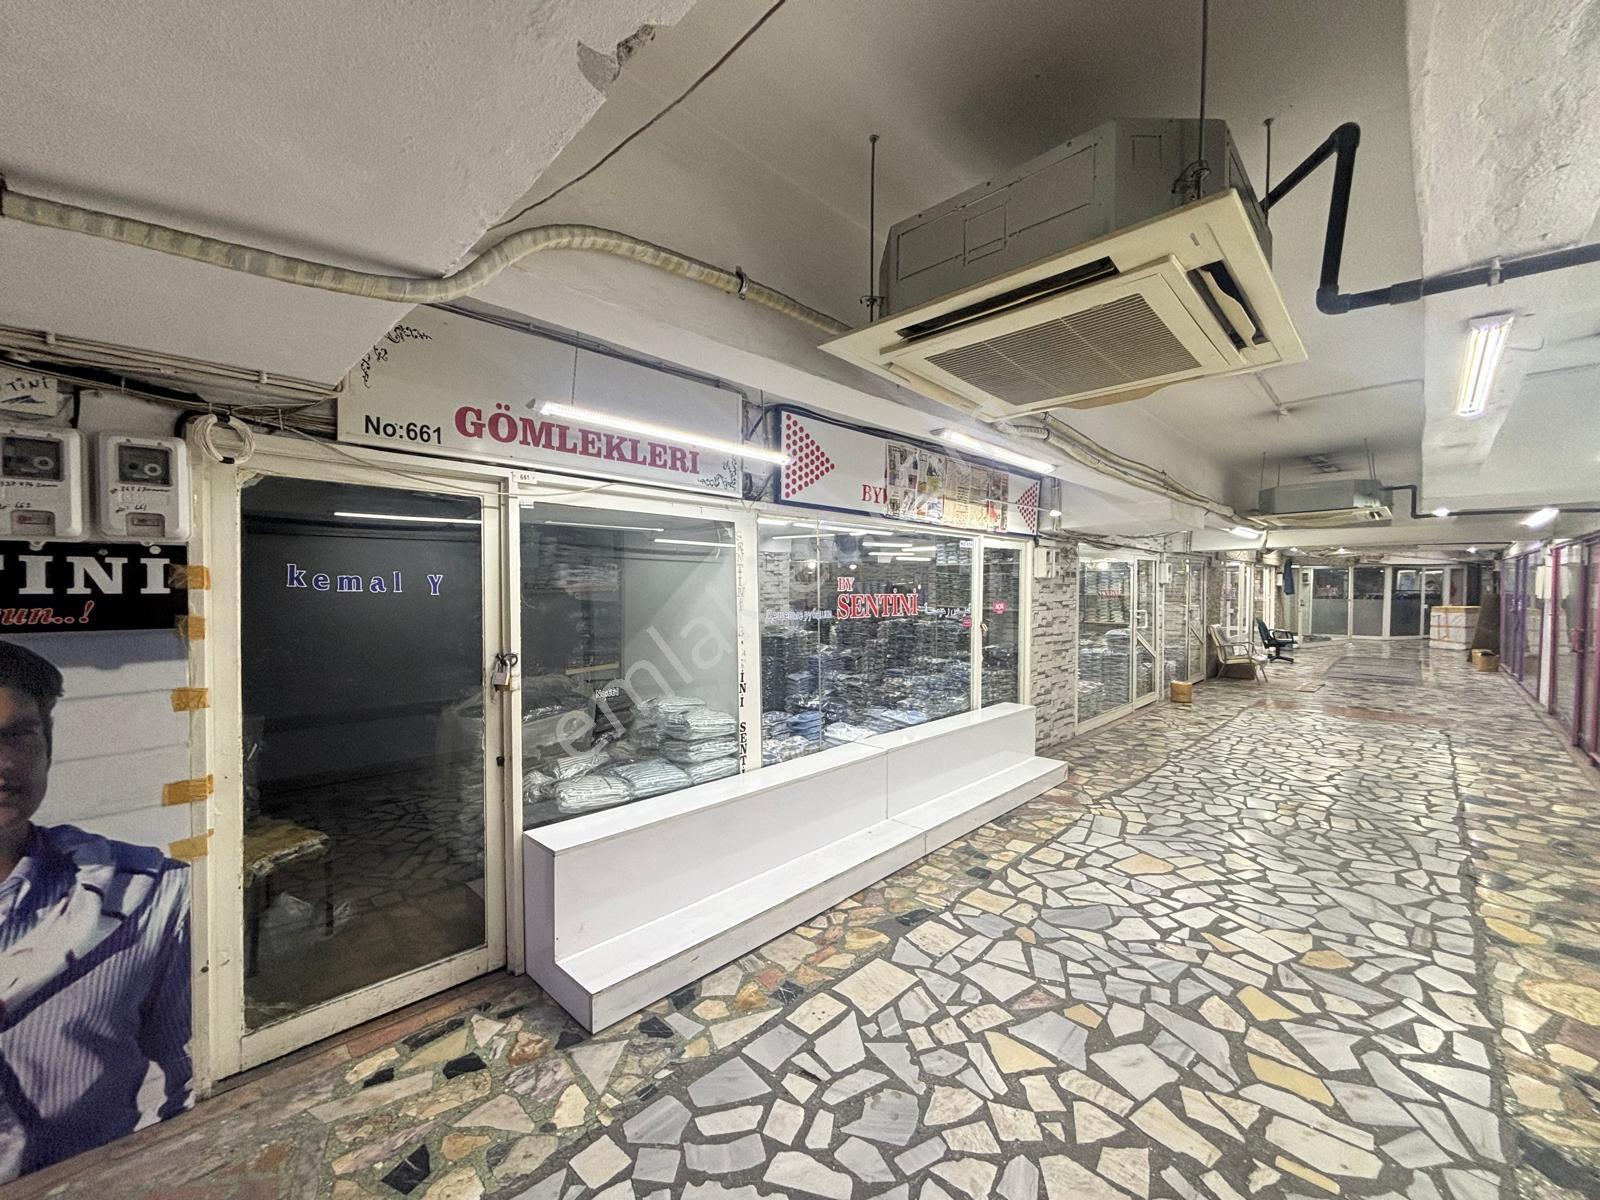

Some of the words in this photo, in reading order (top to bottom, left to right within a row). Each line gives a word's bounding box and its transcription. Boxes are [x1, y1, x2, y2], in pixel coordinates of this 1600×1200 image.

[364, 414, 442, 445] No:661
[454, 402, 700, 475] GÖMLEKLERİ
[0, 546, 171, 595] İNİ
[286, 563, 403, 593] kemal
[426, 574, 444, 596] Y
[837, 576, 855, 592] BY
[0, 600, 95, 626] un..!
[836, 588, 919, 621] SENTİNİ
